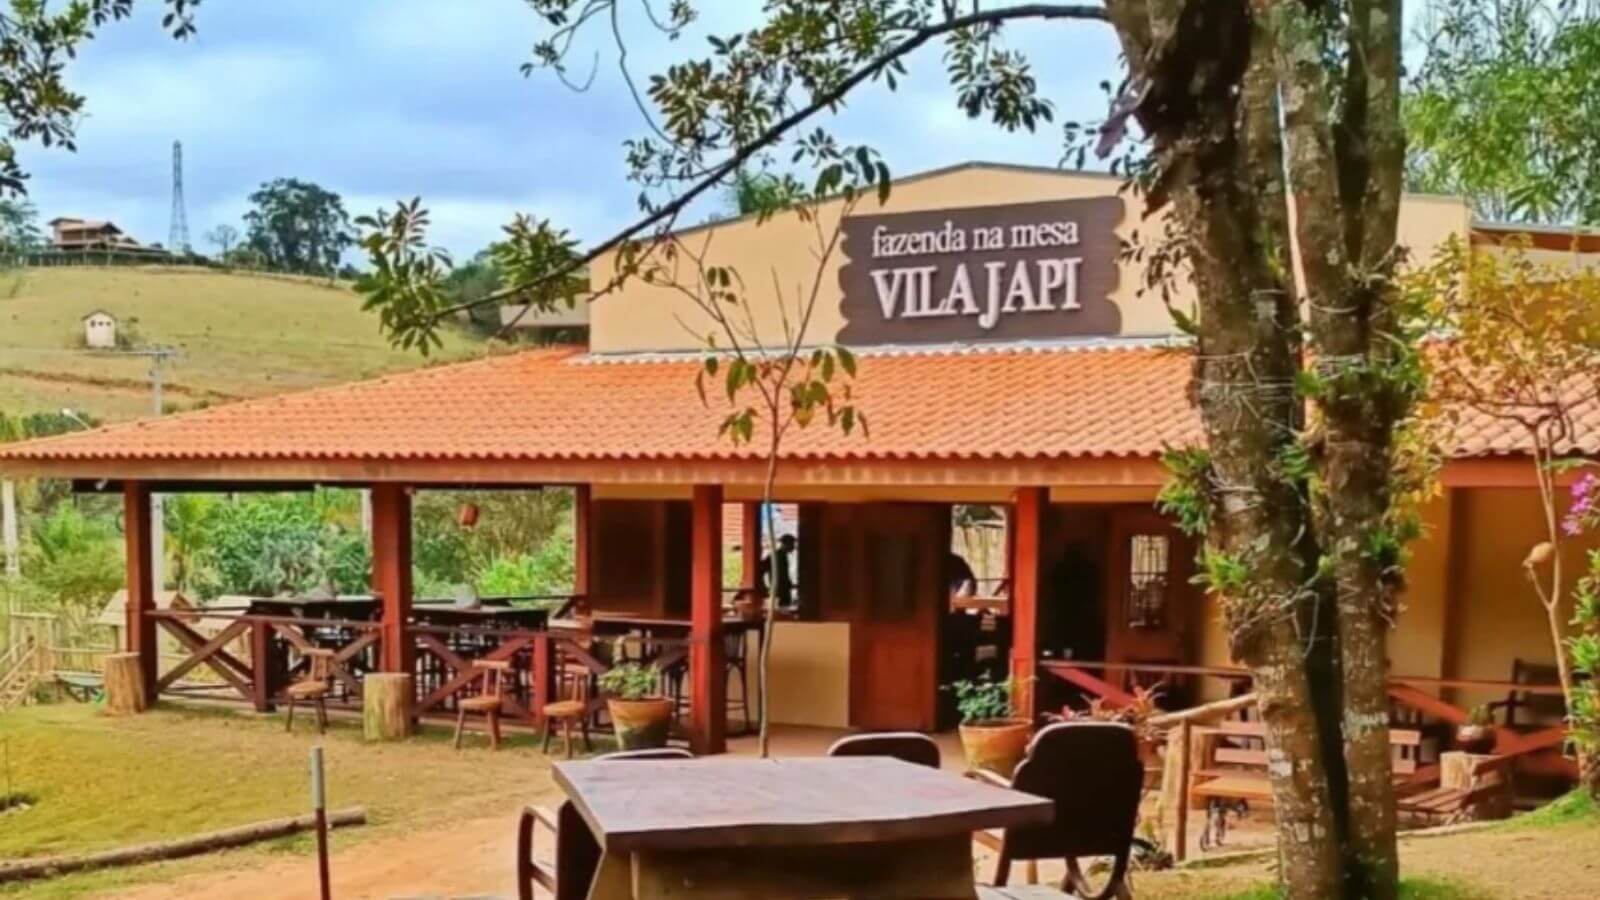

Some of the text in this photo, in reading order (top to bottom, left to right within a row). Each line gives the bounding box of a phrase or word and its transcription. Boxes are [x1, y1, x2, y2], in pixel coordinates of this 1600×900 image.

[872, 221, 1079, 258] fazenda na mesa
[870, 257, 1083, 328] VILA JAPI
